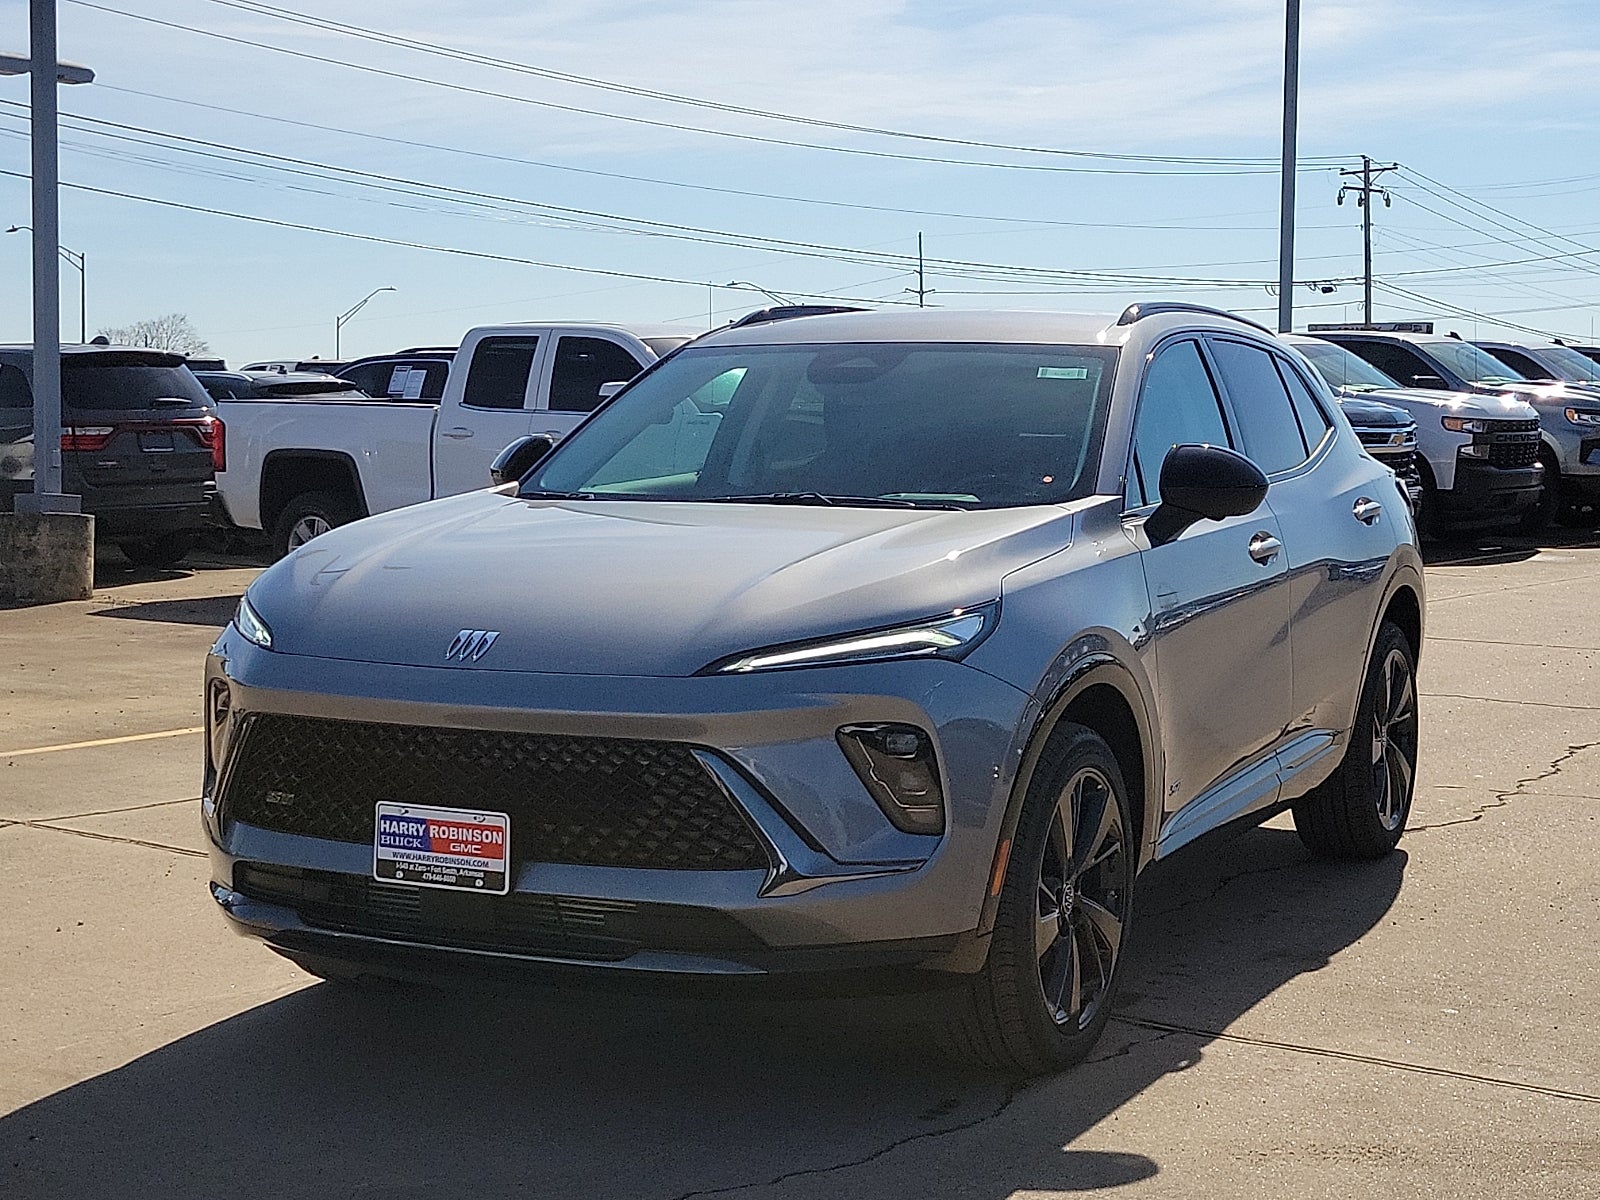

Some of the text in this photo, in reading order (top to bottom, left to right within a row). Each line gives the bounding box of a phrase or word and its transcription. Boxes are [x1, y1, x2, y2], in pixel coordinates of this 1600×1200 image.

[380, 820, 503, 845] HARRY ROBINSON
[380, 835, 424, 848] BUICK
[450, 842, 482, 854] GMC
[392, 852, 489, 868] WWW.HARRYROBINSON.COM
[430, 865, 442, 874] Fort
